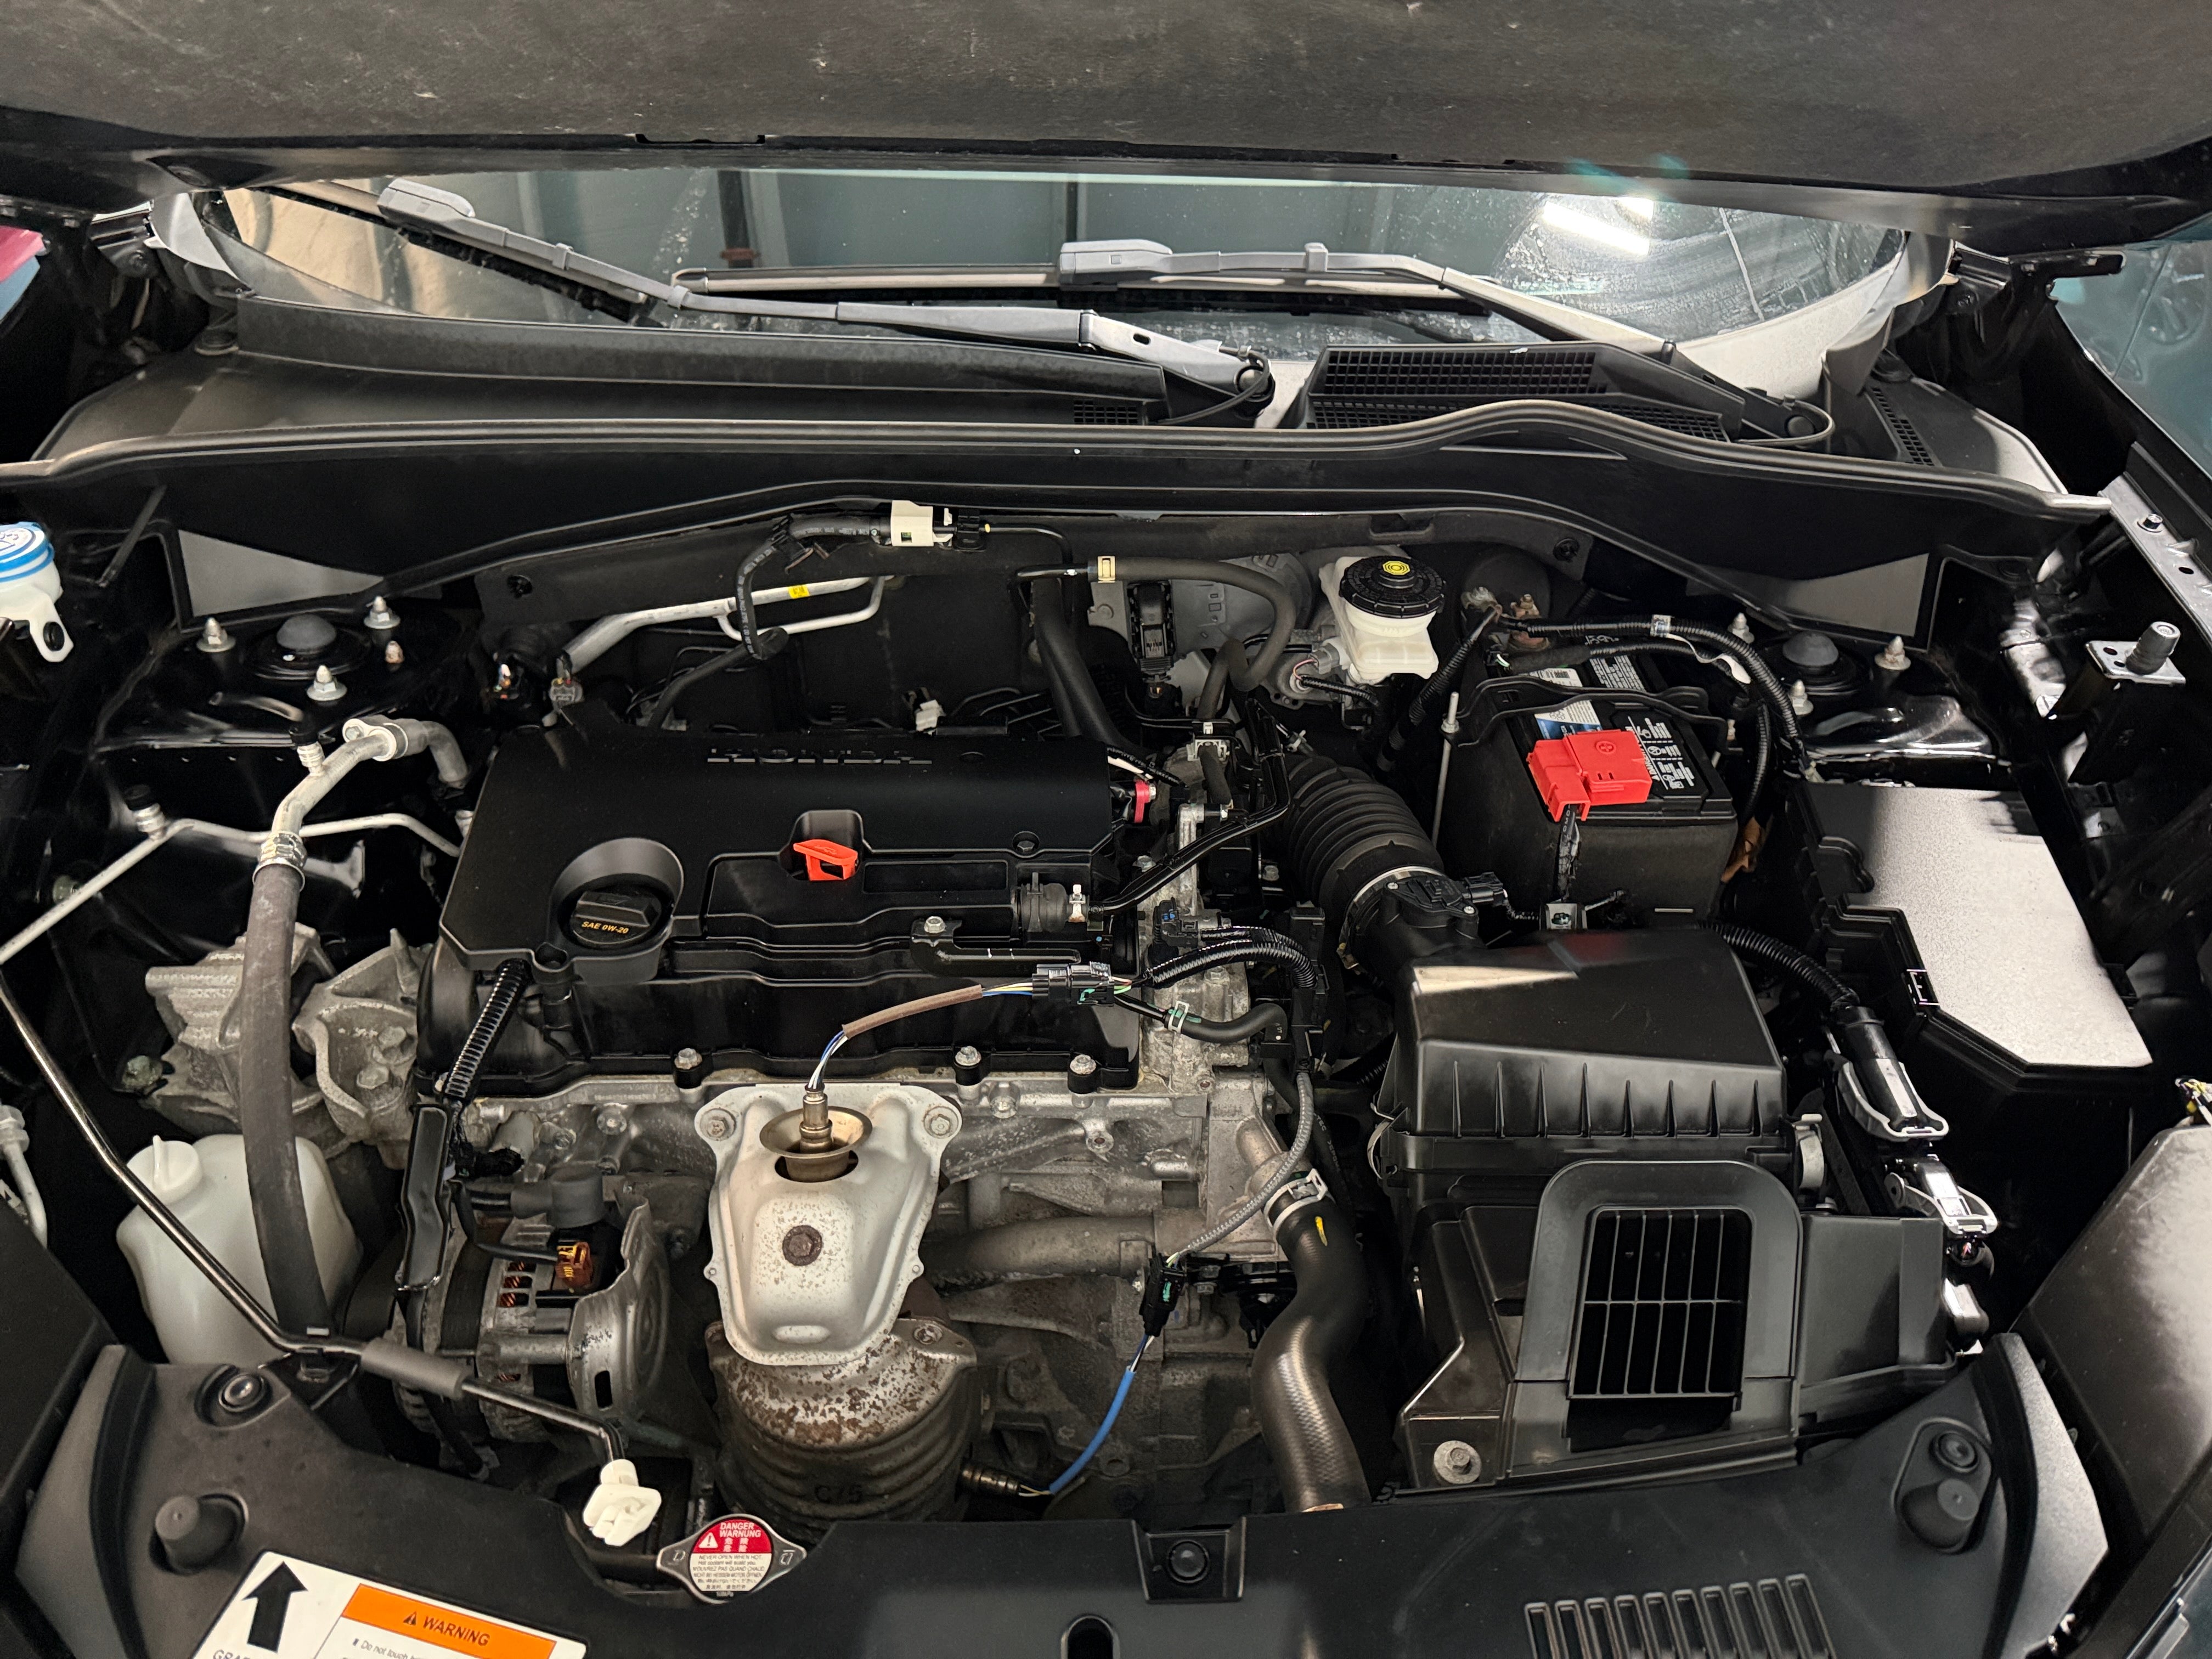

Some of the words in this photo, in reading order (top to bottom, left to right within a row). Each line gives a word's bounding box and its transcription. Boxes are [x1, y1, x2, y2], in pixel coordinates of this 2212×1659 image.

[582, 921, 601, 929] SAE
[602, 924, 629, 934] 0W-20
[720, 1522, 755, 1530] DANGER
[719, 1530, 762, 1538] WARNUNG
[423, 1616, 490, 1647] WARNING
[360, 1640, 373, 1651] Do
[373, 1646, 387, 1656] not
